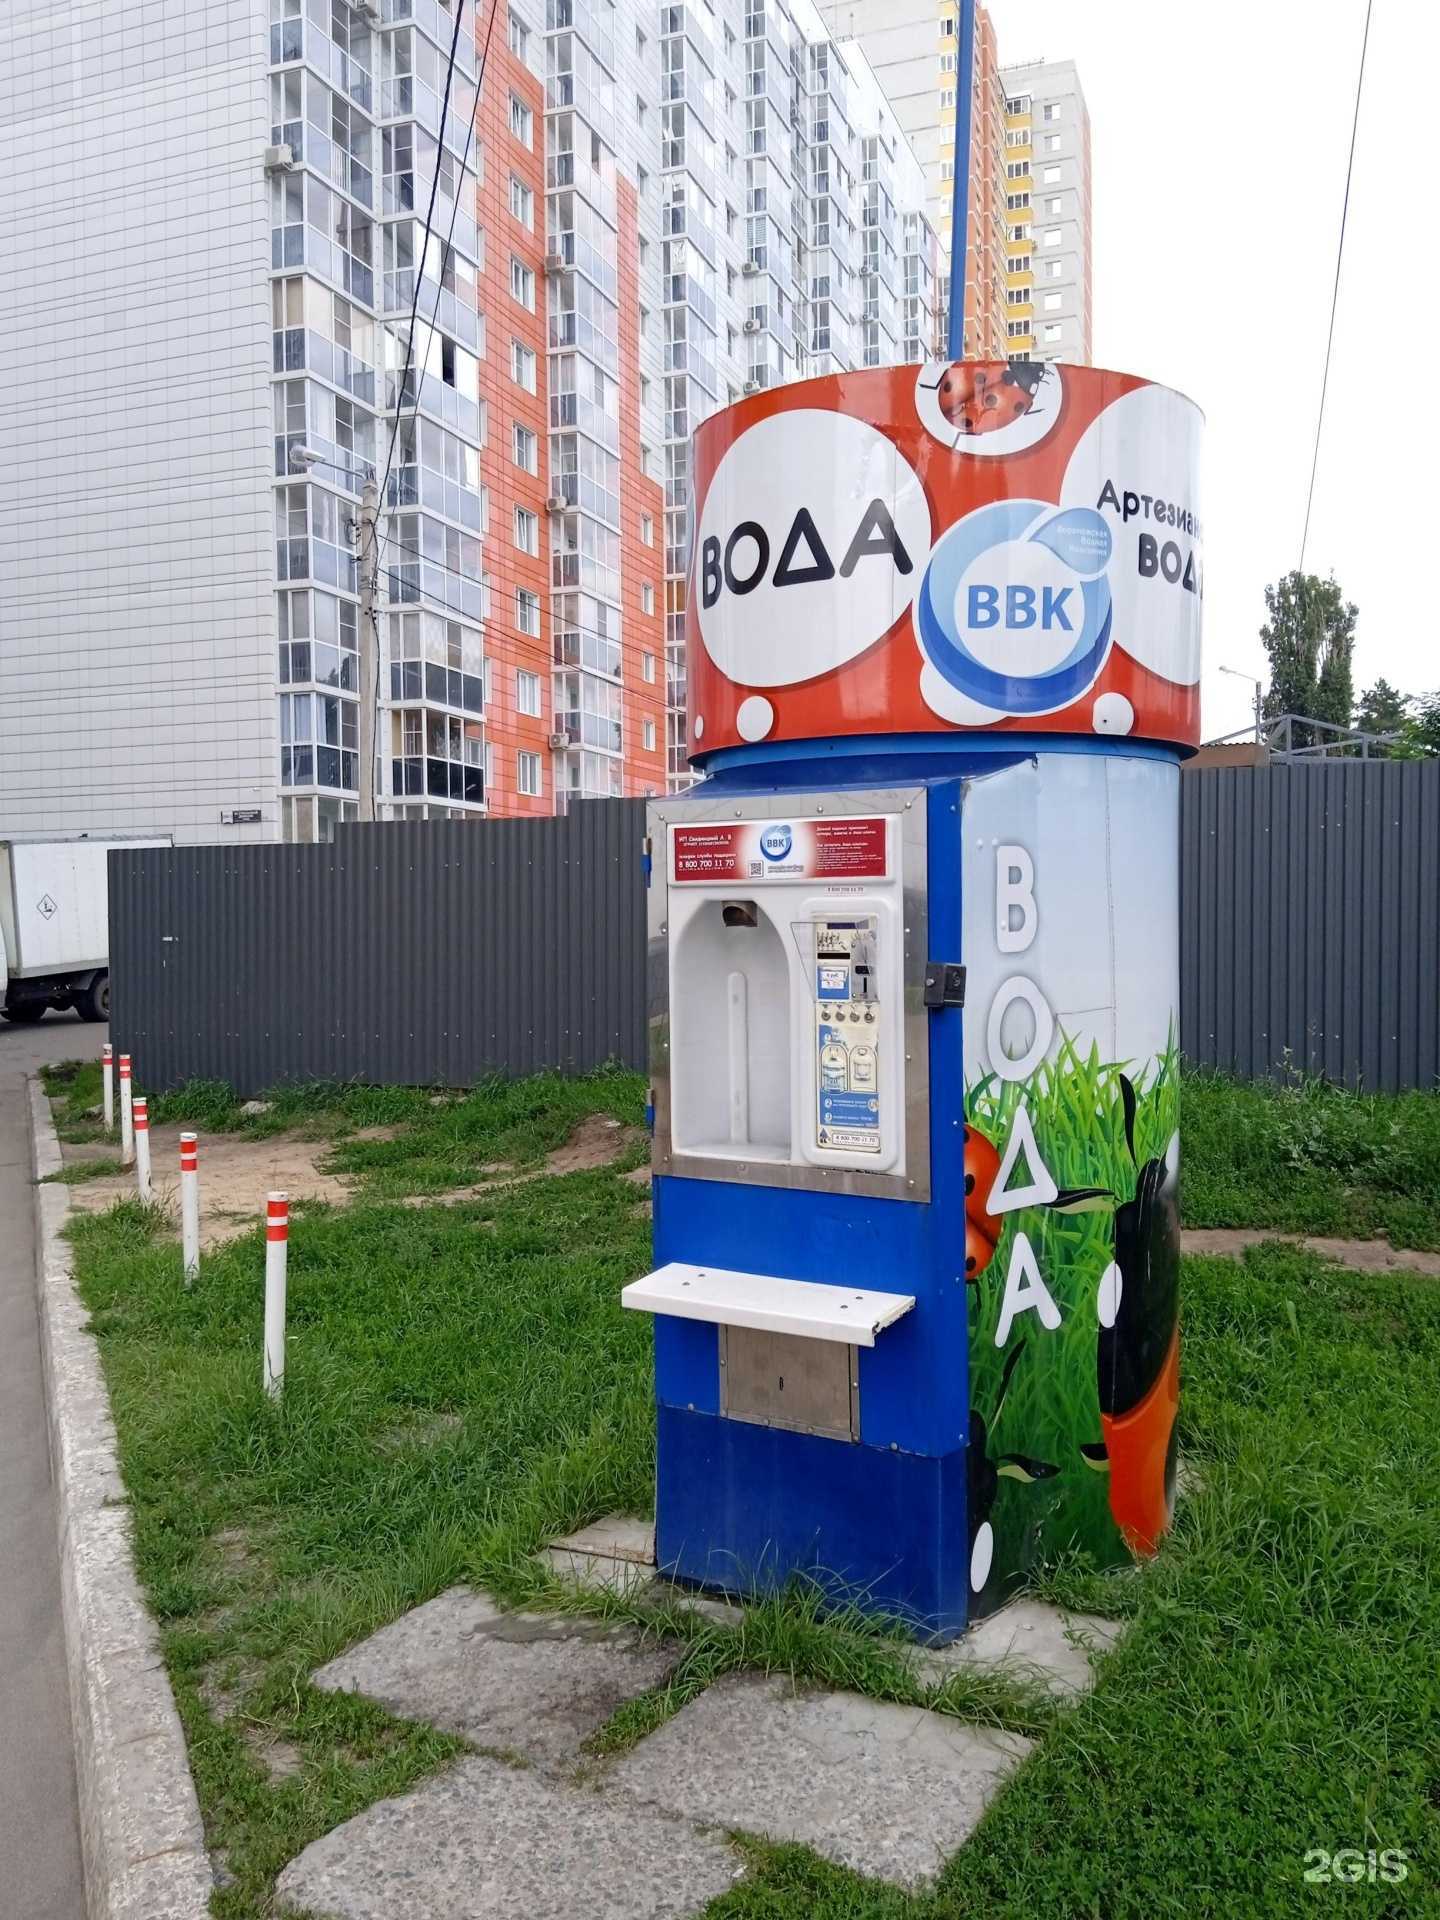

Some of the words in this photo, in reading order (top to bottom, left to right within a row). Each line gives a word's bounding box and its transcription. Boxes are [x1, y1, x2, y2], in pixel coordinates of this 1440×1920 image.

[702, 498, 914, 610] ВОДА
[1138, 532, 1203, 599] ВОД
[967, 584, 1074, 631] ВВК
[678, 860, 684, 868] 8
[685, 860, 698, 868] 800
[699, 859, 713, 867] 700
[714, 859, 723, 867] 11
[725, 859, 735, 867] 70
[767, 838, 785, 848] ВВК
[986, 845, 1061, 1348] ВОДА
